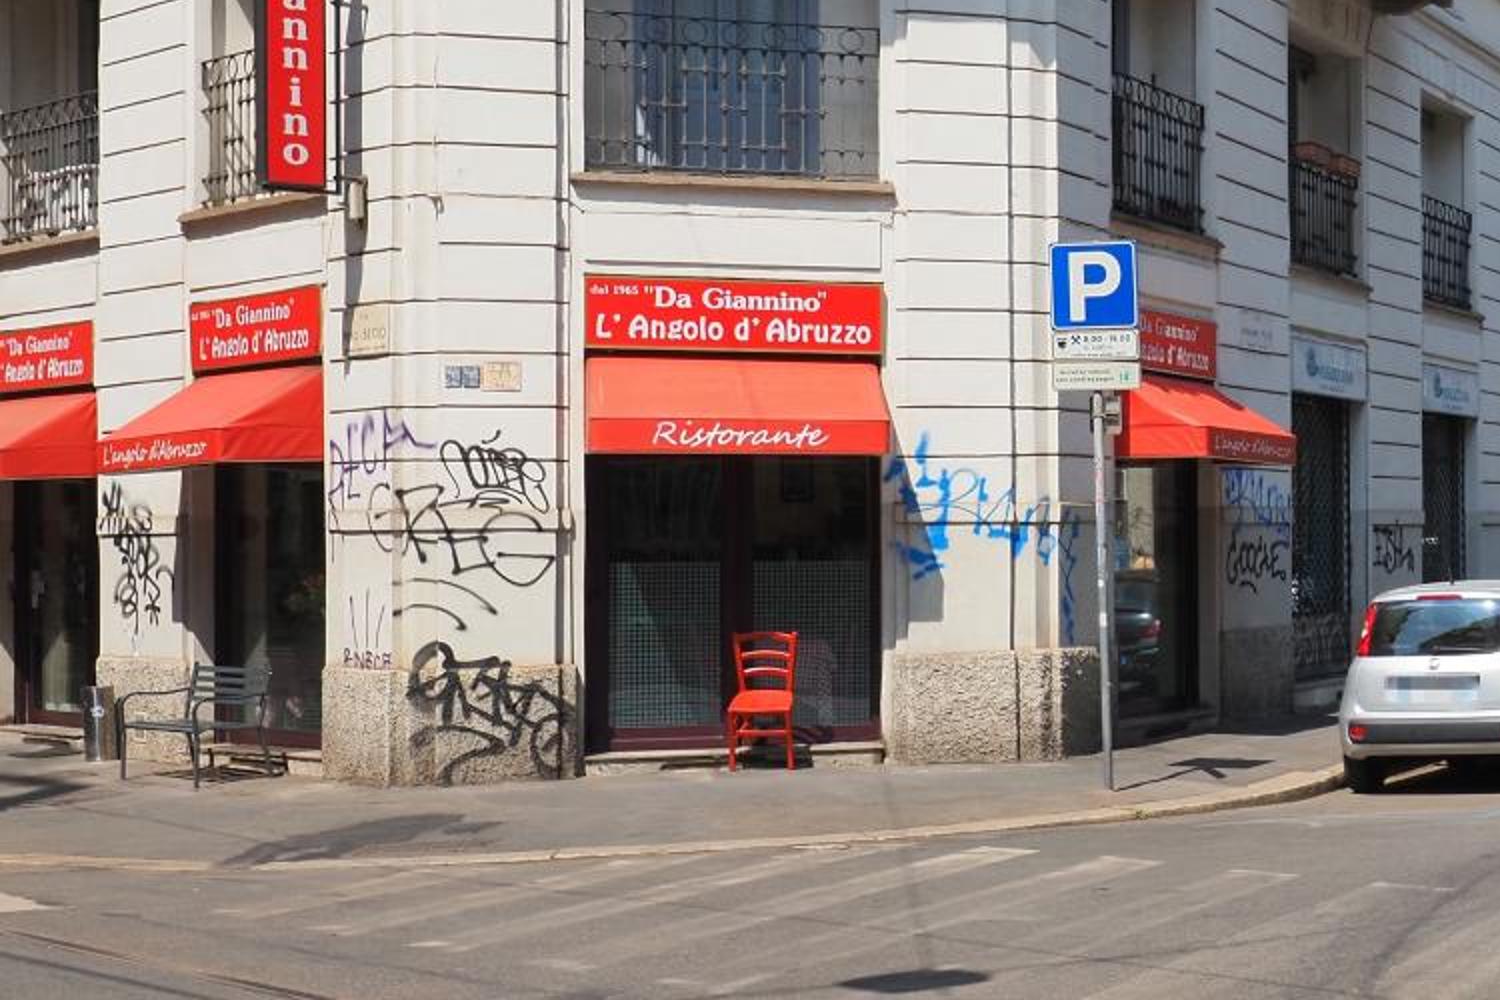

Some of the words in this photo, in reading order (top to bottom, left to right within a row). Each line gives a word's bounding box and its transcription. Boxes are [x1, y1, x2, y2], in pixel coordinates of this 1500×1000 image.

[1067, 251, 1122, 323] P
[264, 327, 309, 353] Abruzzo
[628, 314, 725, 342] Angolo
[765, 318, 872, 345] Abruzzo
[652, 419, 830, 448] Ristorante
